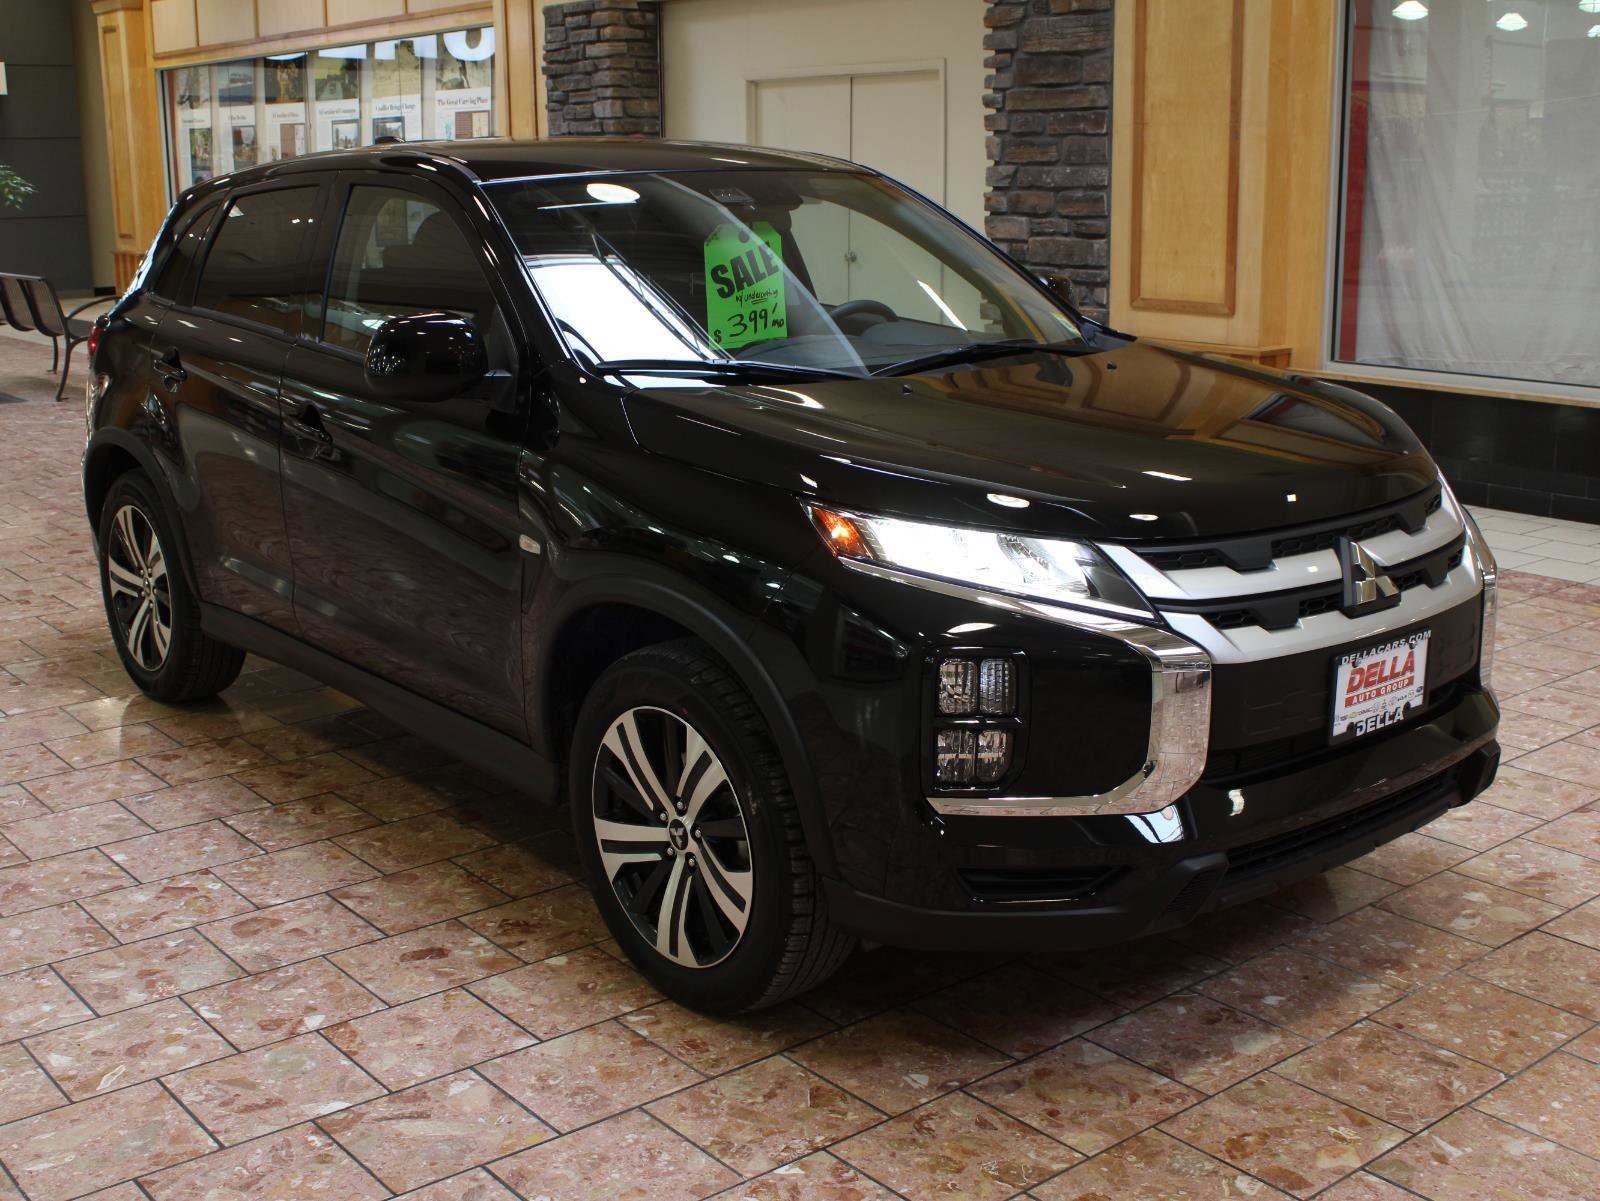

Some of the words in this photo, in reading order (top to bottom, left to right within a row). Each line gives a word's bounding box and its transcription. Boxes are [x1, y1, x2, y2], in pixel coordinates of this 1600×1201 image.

[711, 244, 779, 298] SALE
[727, 309, 768, 338] 399
[1341, 629, 1431, 666] DELLACARS.COM
[1346, 650, 1415, 695] DELLA
[1352, 690, 1377, 704] AUTO
[1380, 679, 1409, 695] GROUP
[1355, 706, 1404, 737] DELLA
